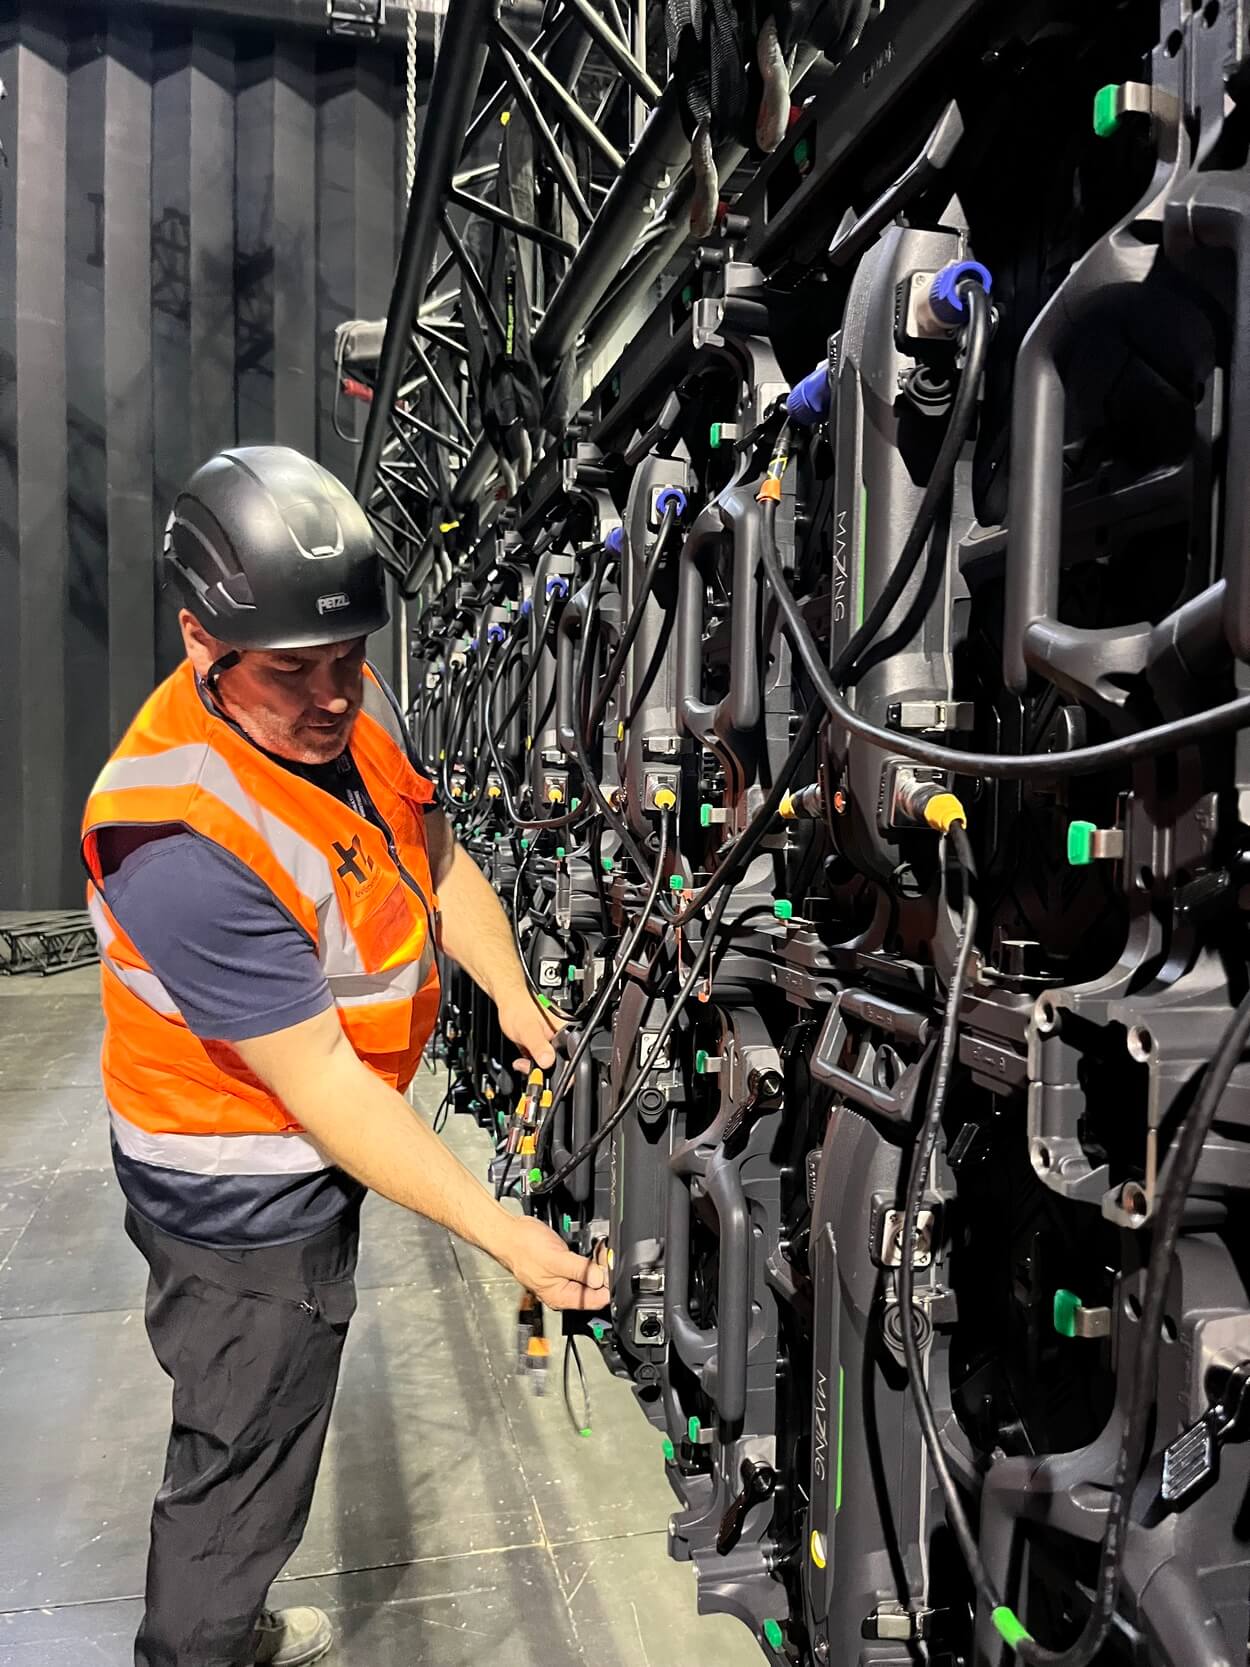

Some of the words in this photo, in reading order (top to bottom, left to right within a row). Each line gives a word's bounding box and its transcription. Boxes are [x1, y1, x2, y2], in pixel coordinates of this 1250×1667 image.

[317, 595, 350, 615] PETZL
[833, 511, 848, 622] MAZING
[815, 1368, 828, 1481] MAZING
